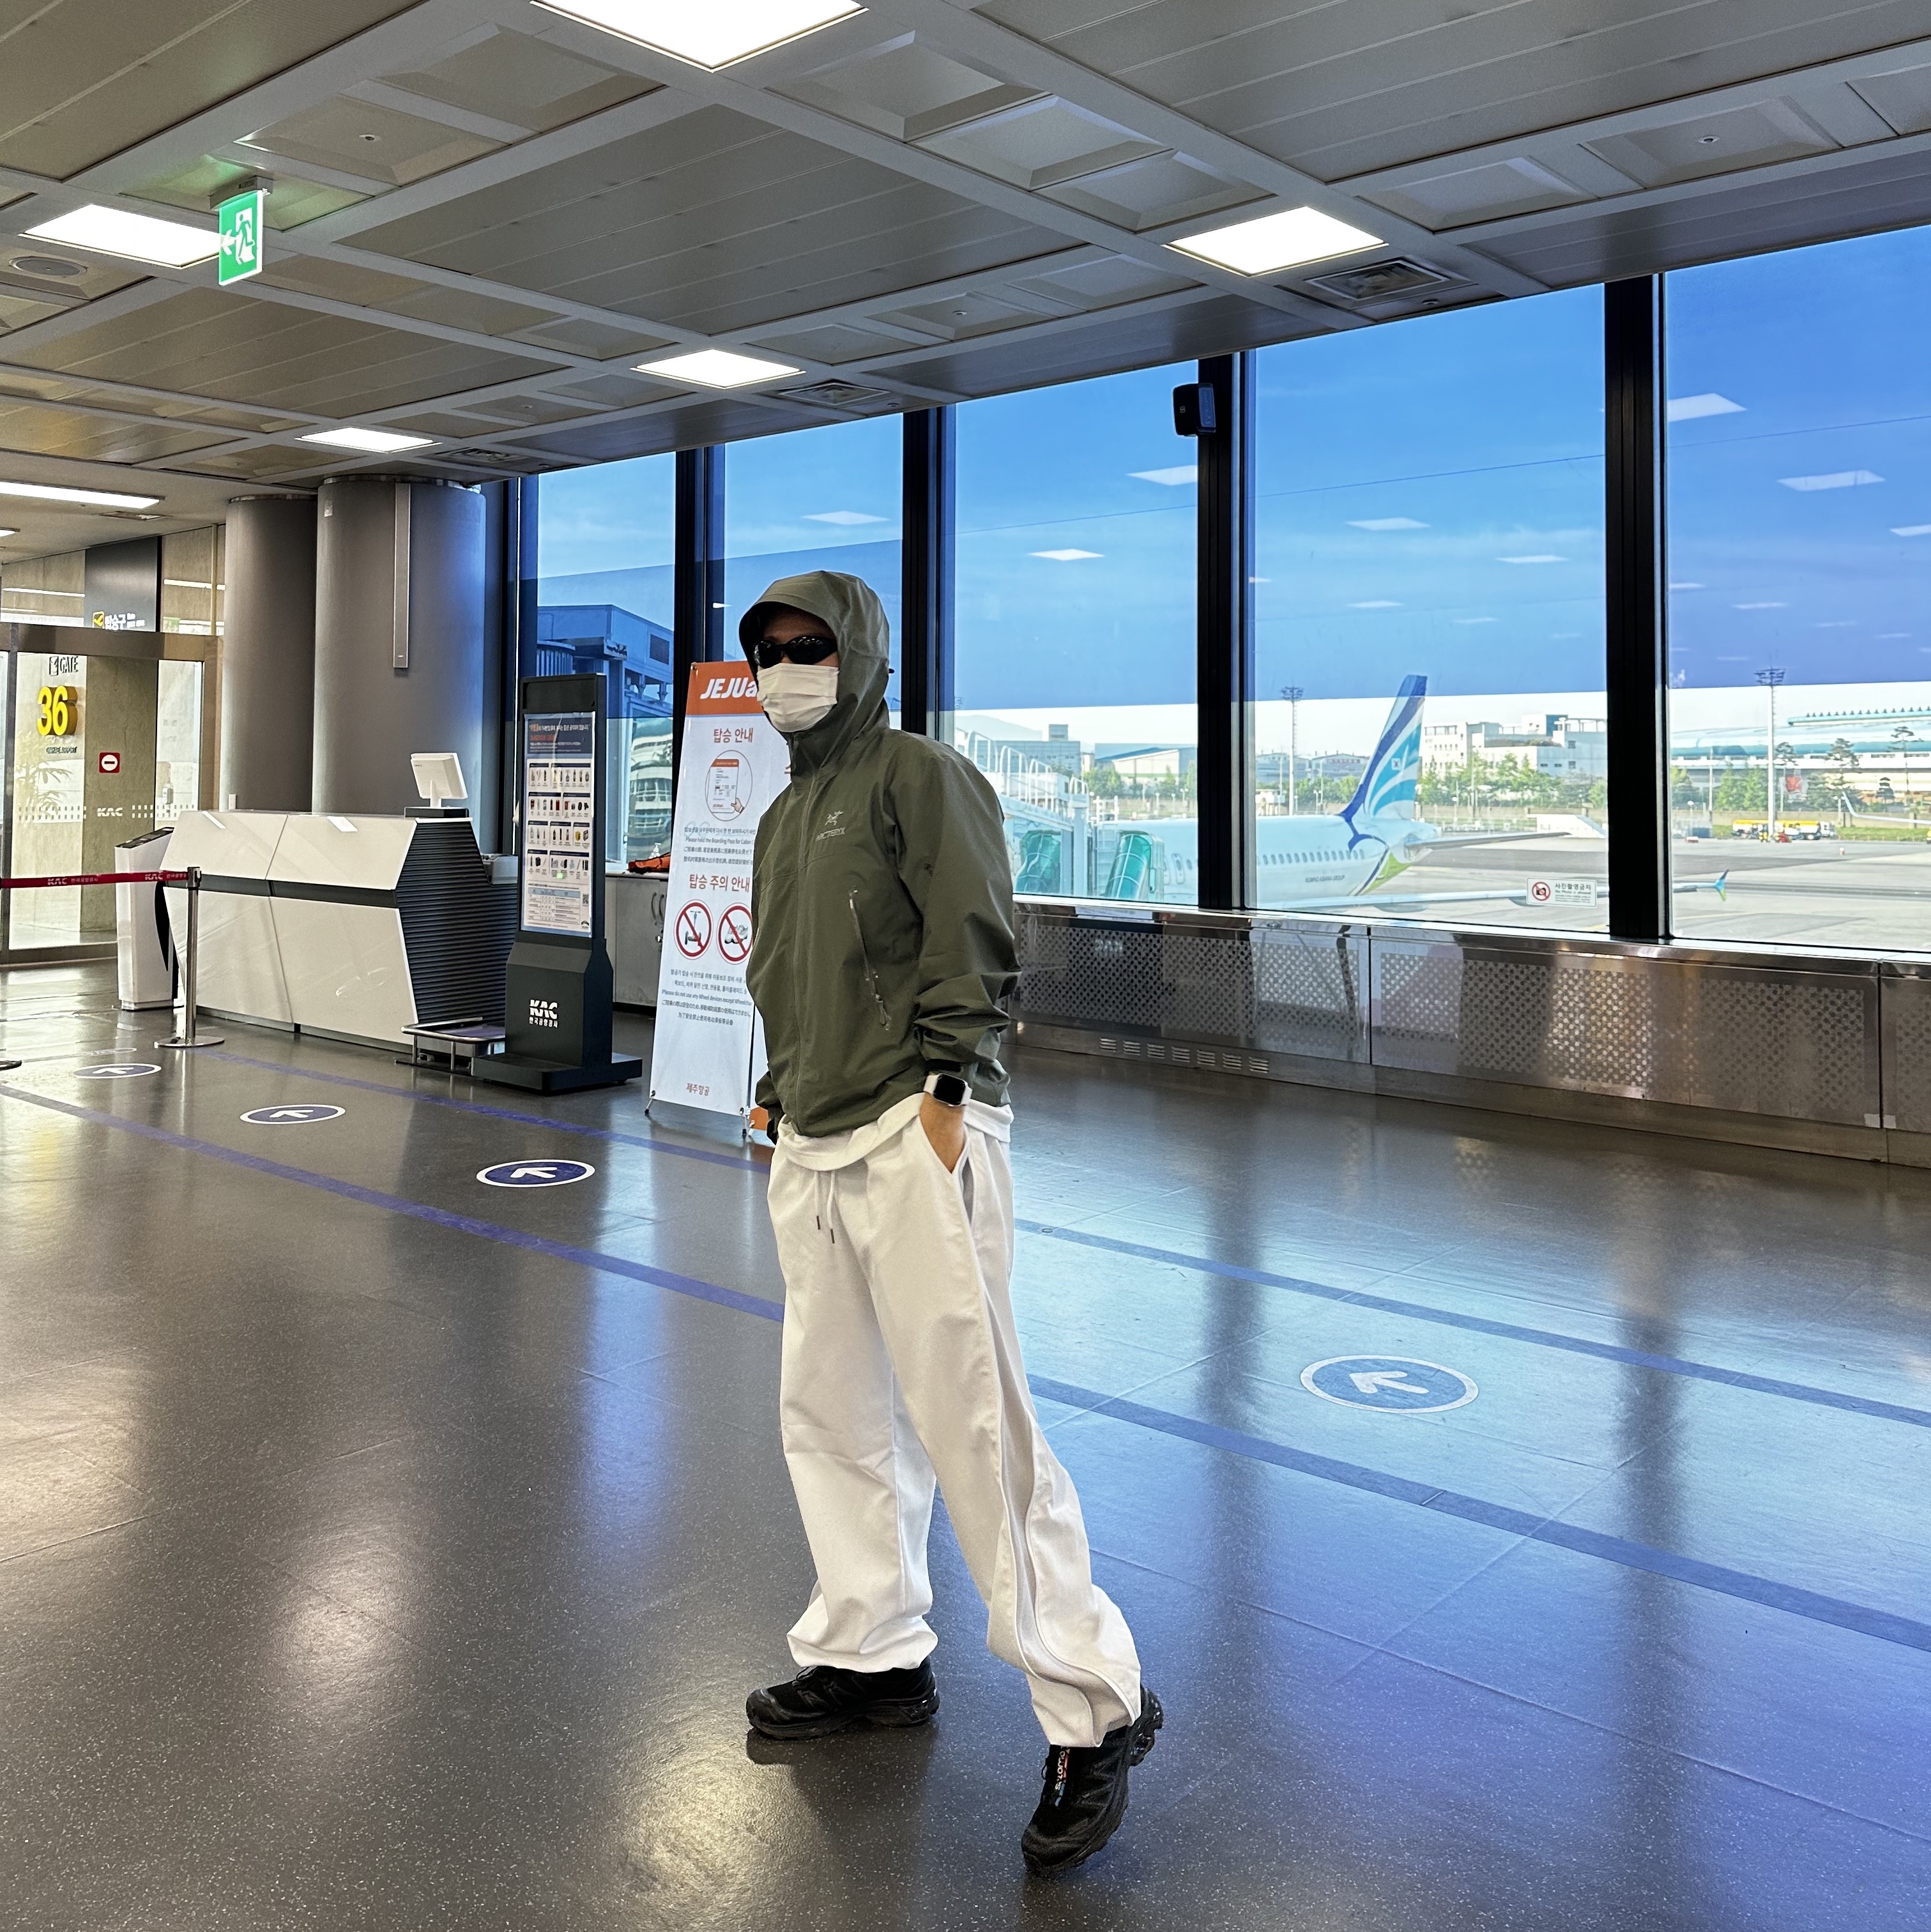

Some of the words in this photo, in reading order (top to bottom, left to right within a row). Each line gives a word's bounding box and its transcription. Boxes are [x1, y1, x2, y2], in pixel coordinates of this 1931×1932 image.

[699, 677, 758, 699] JEJUa
[37, 685, 68, 736] 36
[714, 727, 732, 743] 탑승
[735, 727, 754, 743] 안내
[97, 807, 123, 817] KAC
[690, 874, 707, 890] 탑승
[710, 875, 728, 892] 주의
[731, 876, 750, 893] 안내
[530, 999, 558, 1019] KAC
[686, 1083, 710, 1097] 제주항공
